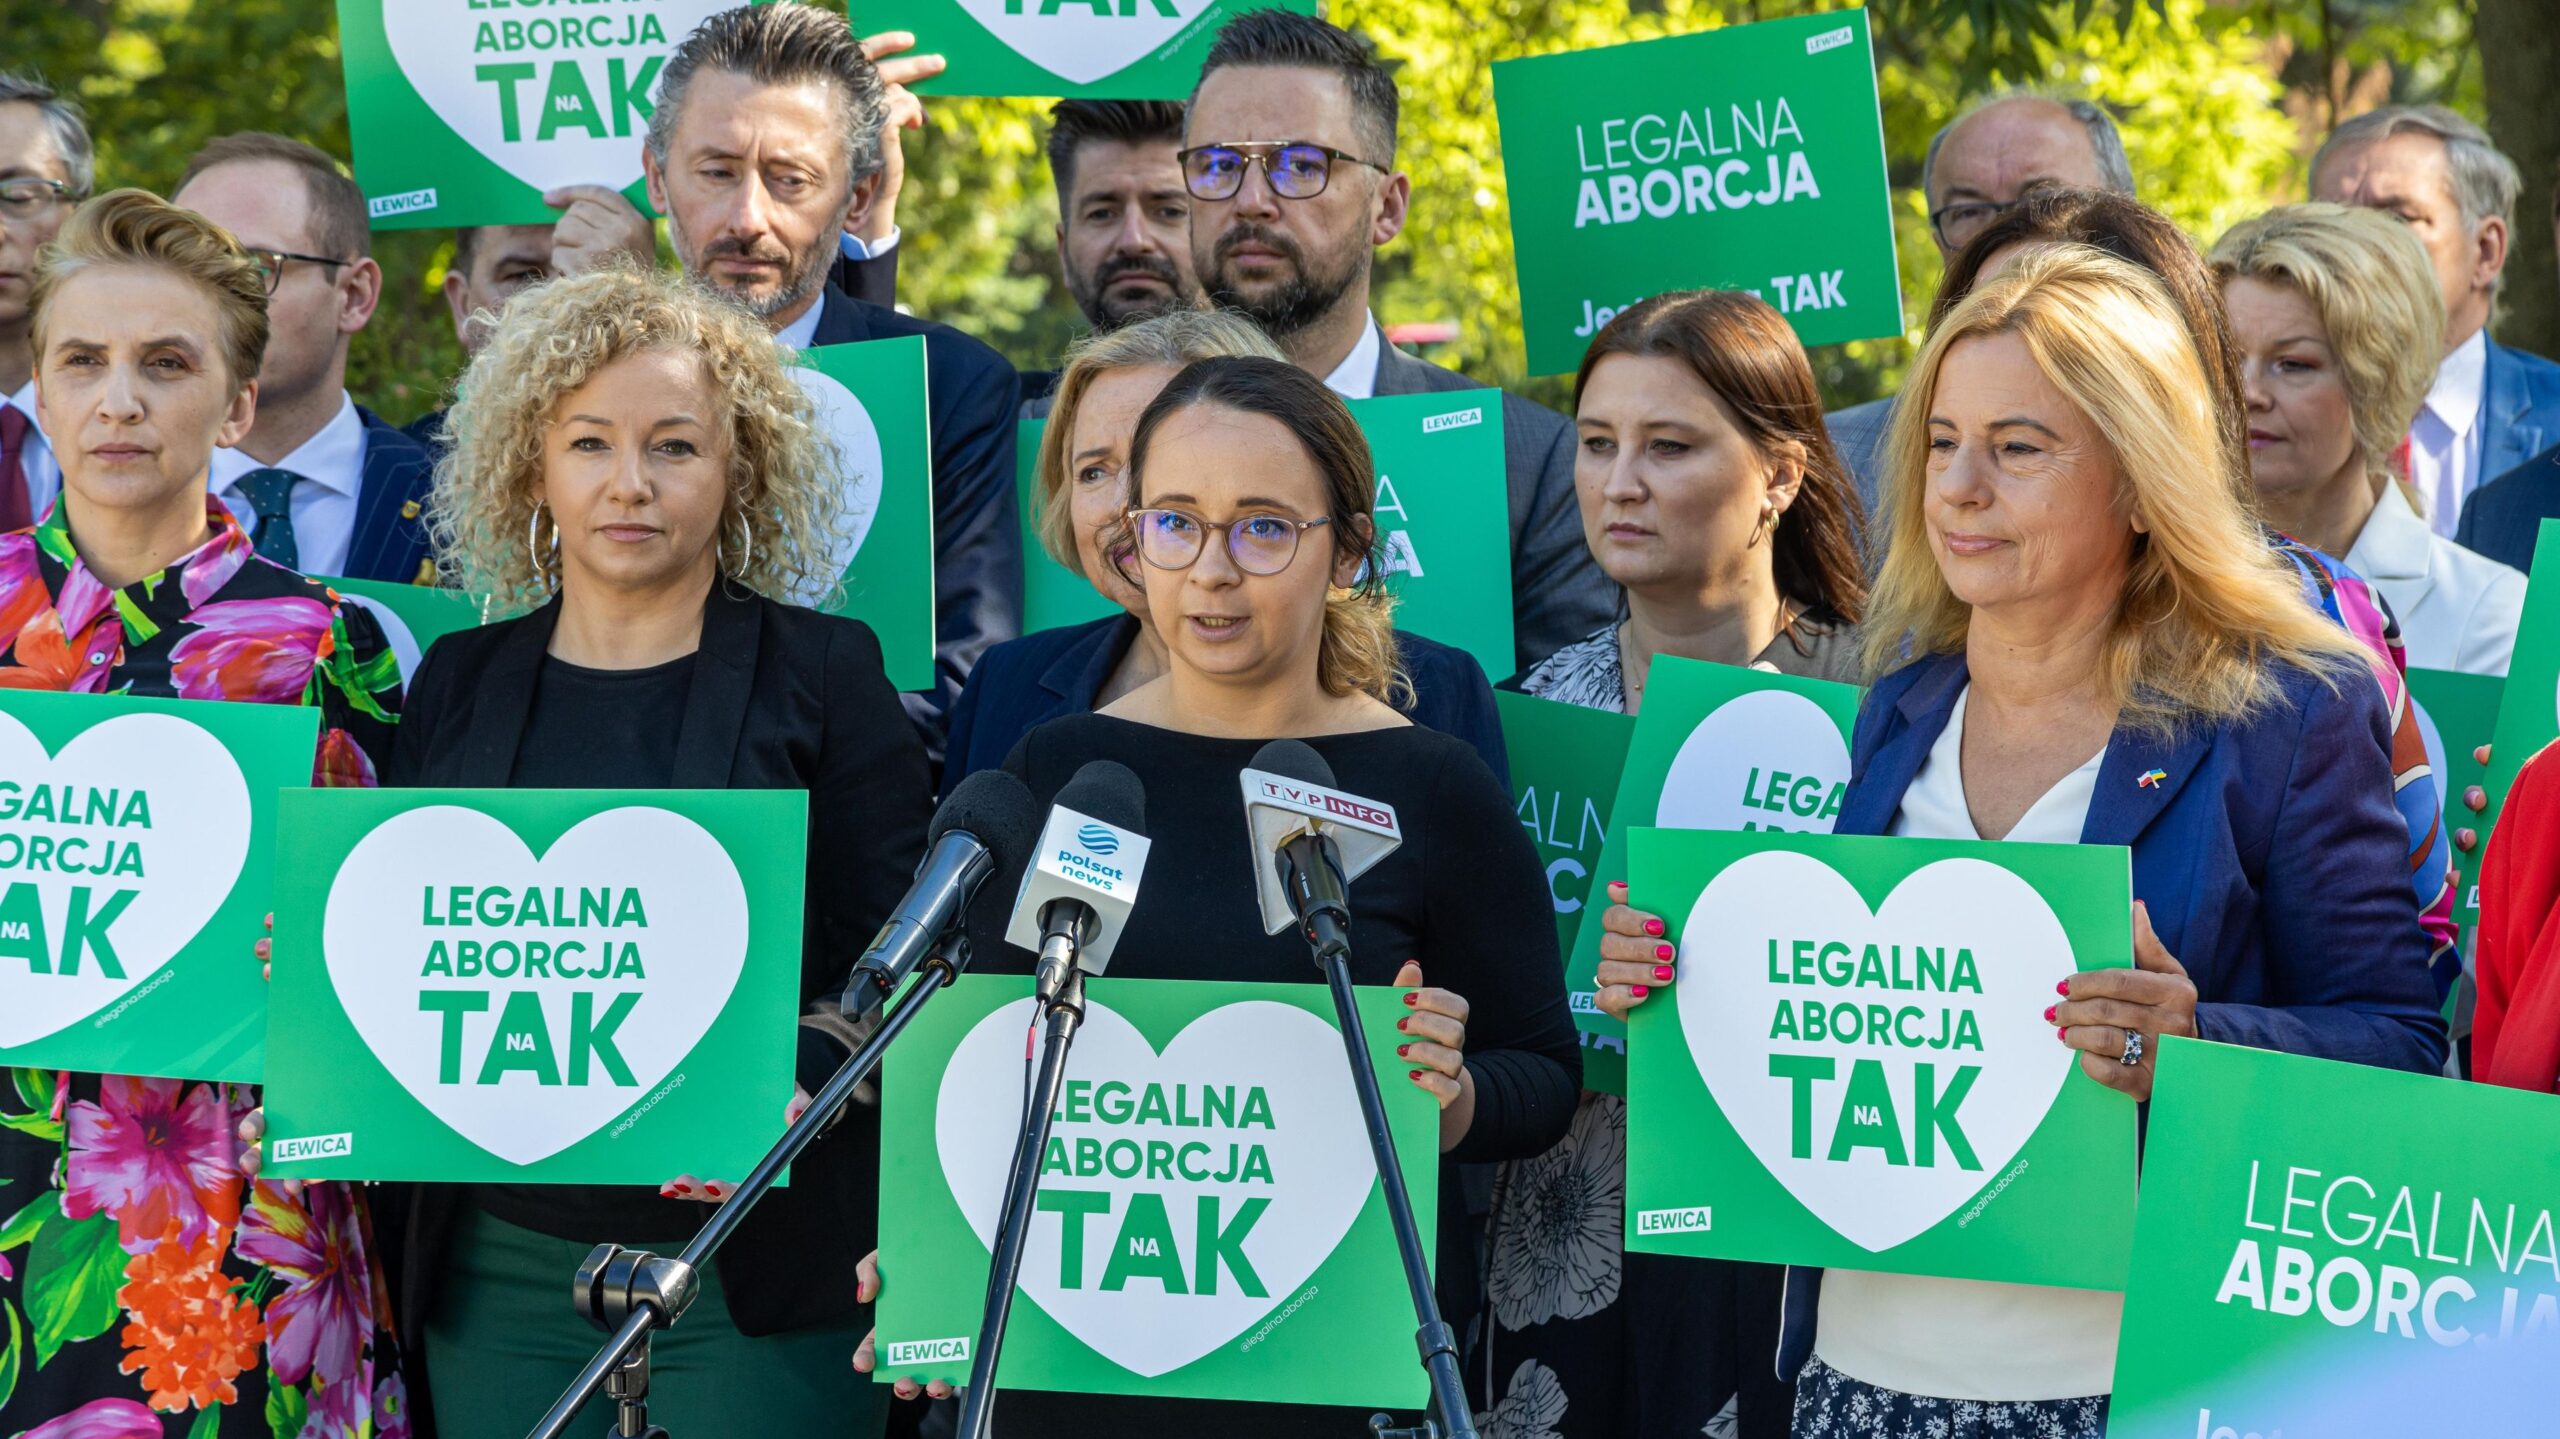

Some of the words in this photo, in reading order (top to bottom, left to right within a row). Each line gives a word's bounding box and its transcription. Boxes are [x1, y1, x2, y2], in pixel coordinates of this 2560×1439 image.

[474, 13, 667, 53] ABORCJA
[1808, 28, 1851, 51] LEWICA
[474, 54, 668, 143] TAK
[554, 94, 584, 113] NA
[1576, 96, 1805, 173] LEGALNA
[372, 191, 434, 215] LEWICA
[1574, 150, 1821, 229] ABORCJA
[1770, 269, 1848, 315] TAK
[1426, 410, 1480, 430] LEWICA
[0, 780, 152, 829] GALNA
[1265, 781, 1322, 807] TVP
[1328, 797, 1391, 827] INFO
[1742, 766, 1846, 820] LEGA
[0, 832, 145, 878] ORCJA
[1058, 848, 1123, 882] polsat
[1062, 864, 1113, 891] news
[421, 885, 649, 928] LEGALNA
[0, 881, 141, 980] AK
[1, 921, 31, 940] NA
[420, 940, 646, 979] ABORCJA
[1767, 938, 1984, 995] LEGALNA
[418, 990, 644, 1087] TAK
[505, 1032, 536, 1052] NA
[1768, 999, 1985, 1052] ABORCJA
[608, 1072, 687, 1140] @legalna.aborcja
[1768, 1053, 1985, 1172] TAK
[1853, 1105, 1883, 1127] NA
[277, 1136, 348, 1159] LEWICA
[1040, 1136, 1275, 1185] ABORCJA
[1956, 1158, 2030, 1230] @legalna.aborcja
[1035, 1188, 1273, 1299] TAK
[1641, 1211, 1708, 1231] LEWICA
[2244, 1159, 2560, 1284] LEGALNA
[1129, 1236, 1161, 1258] NA
[1239, 1284, 1320, 1354] @legalna.aborcja
[891, 1341, 966, 1363] LEWICA
